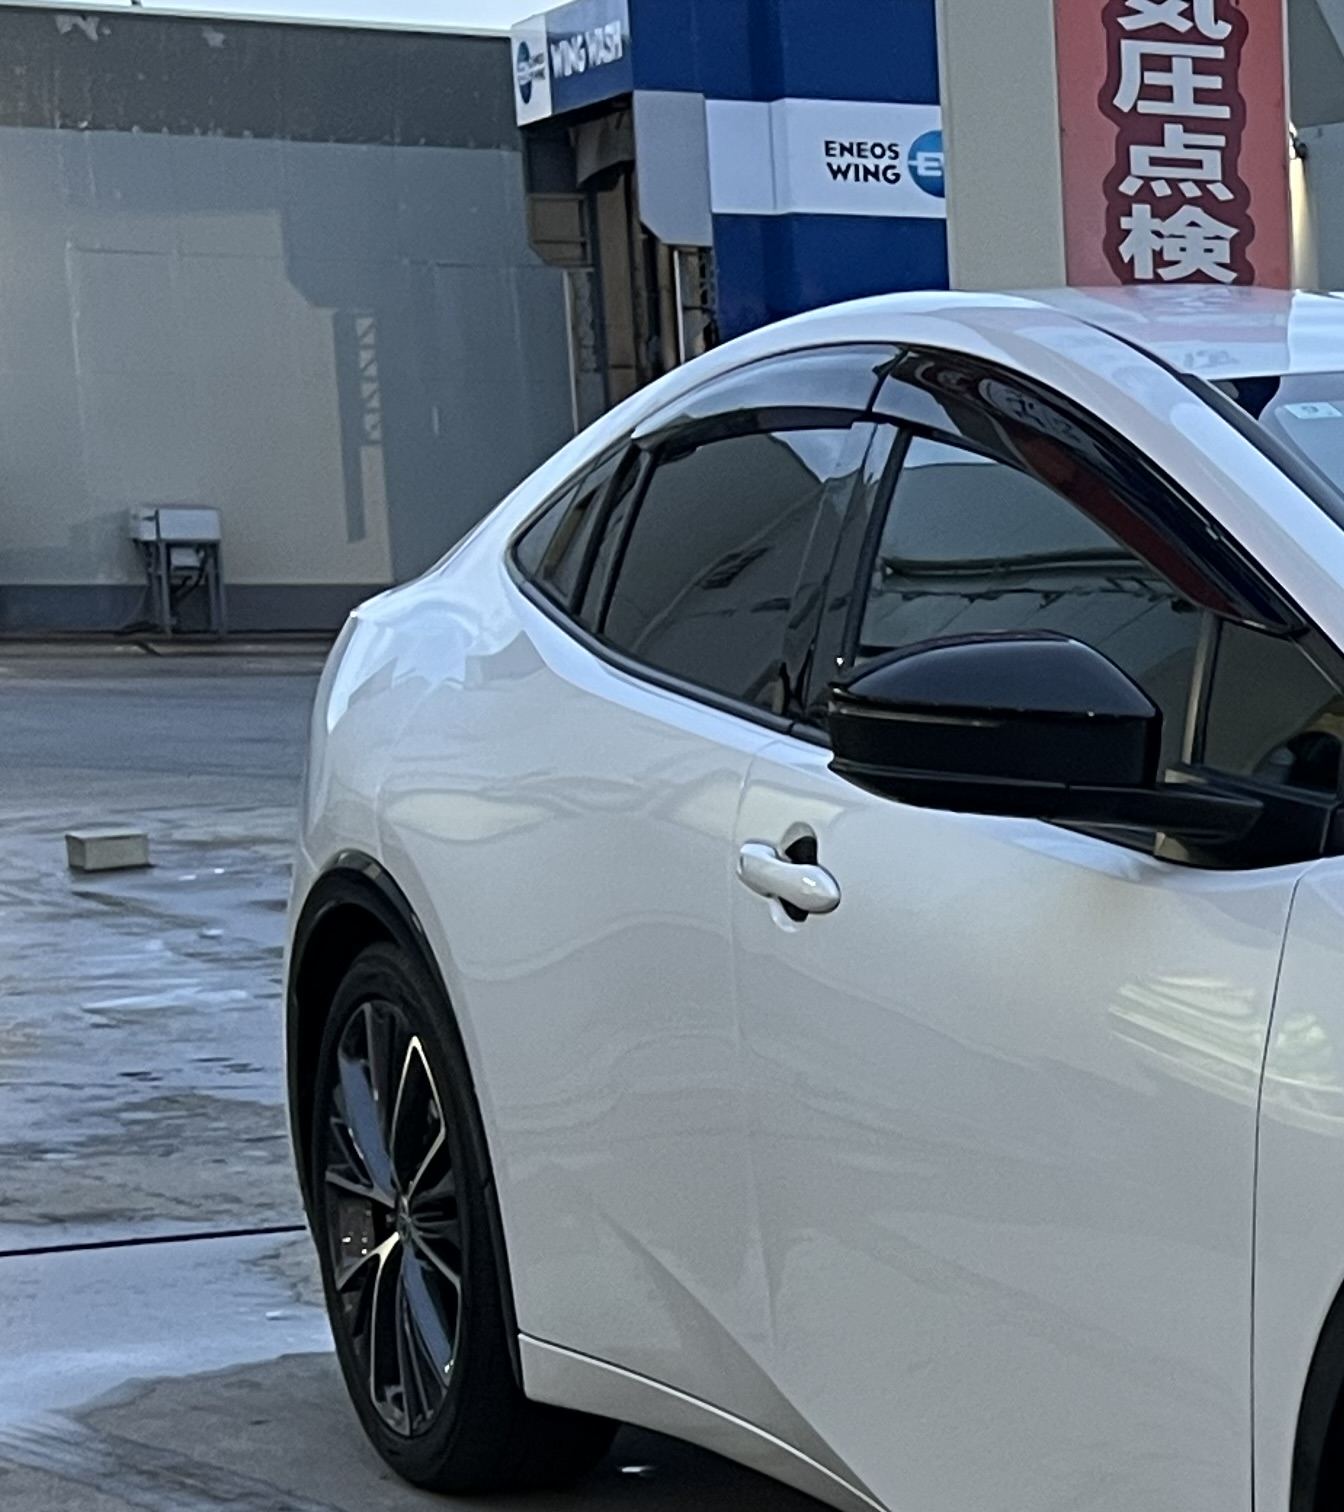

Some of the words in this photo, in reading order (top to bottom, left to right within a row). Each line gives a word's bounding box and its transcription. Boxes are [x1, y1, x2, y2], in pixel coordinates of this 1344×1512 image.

[550, 34, 586, 79] WING
[584, 20, 623, 68] WASH
[823, 139, 900, 161] ENEOS
[826, 161, 902, 185] WING
